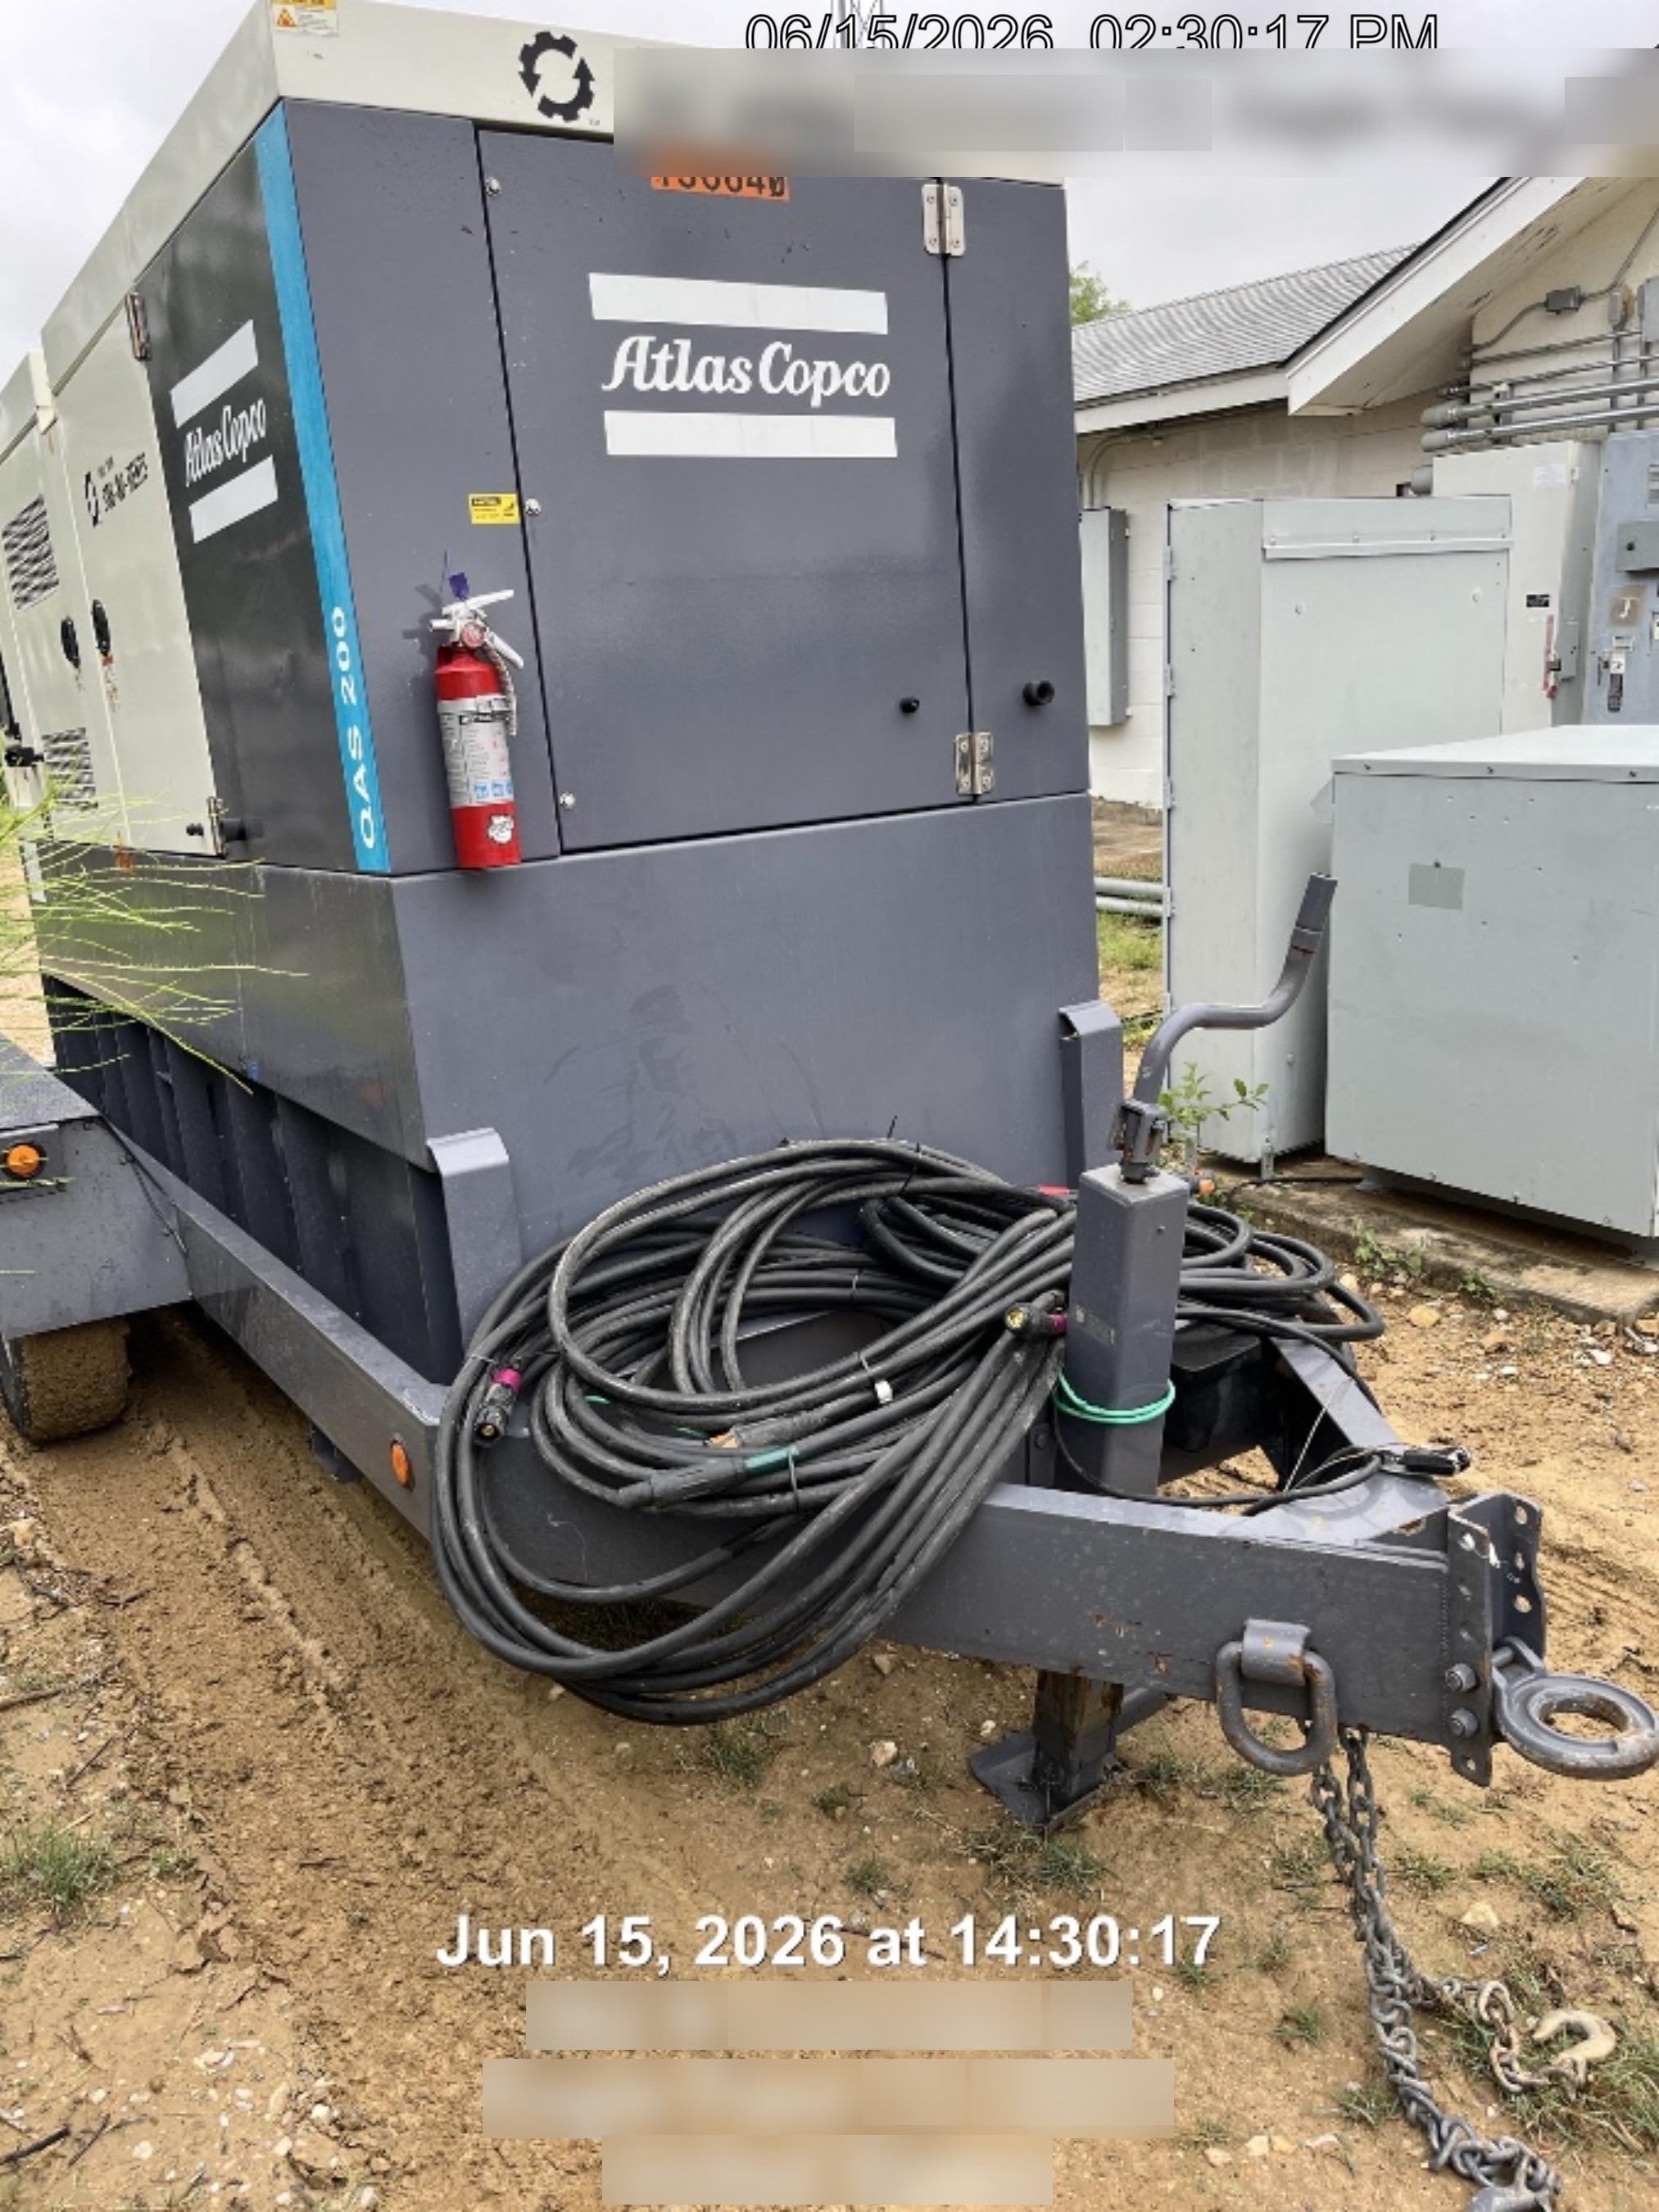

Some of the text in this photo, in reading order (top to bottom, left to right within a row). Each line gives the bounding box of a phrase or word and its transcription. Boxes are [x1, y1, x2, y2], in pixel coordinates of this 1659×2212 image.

[601, 335, 891, 407] Atlas Copco
[185, 427, 224, 487] Atlas
[222, 398, 266, 463] Copco
[331, 605, 375, 850] QAS 200
